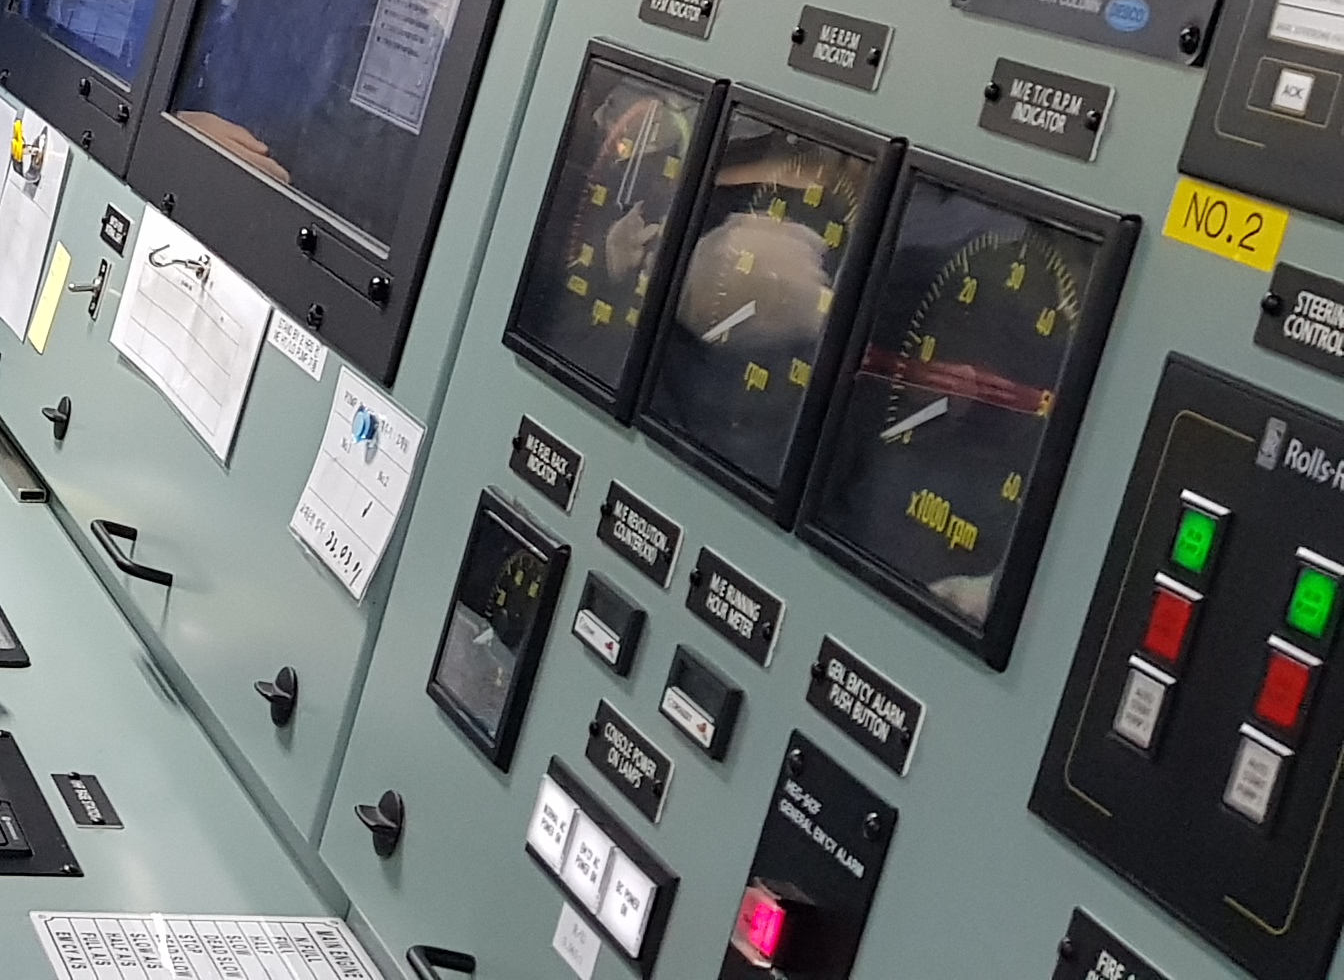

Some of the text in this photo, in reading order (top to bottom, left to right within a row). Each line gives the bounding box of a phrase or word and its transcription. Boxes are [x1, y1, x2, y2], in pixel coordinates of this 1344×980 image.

[666, 0, 702, 23] INDICATOR
[813, 42, 857, 69] INDICATOR
[1010, 77, 1033, 102] M/E
[1033, 84, 1054, 108] T/C
[1012, 101, 1067, 134] INDICATOR
[1184, 191, 1264, 252] NO.2
[958, 275, 978, 305] 20
[1003, 261, 1026, 291] 30
[1035, 306, 1057, 337] 40
[1293, 290, 1344, 329] STEERIN
[919, 334, 937, 363] 10
[526, 452, 558, 487] INDICATOR
[627, 511, 669, 551] REVOLUTION
[906, 488, 980, 552] x1000 rpm
[709, 572, 762, 623] M/E RUNNING
[705, 593, 755, 640] HOUR METER
[829, 682, 853, 716] PUSH
[850, 699, 891, 744] BUTTON
[604, 721, 658, 779] CONSOLE POWER
[607, 747, 644, 789] ON LAMPS
[777, 797, 814, 835] GENERAL
[834, 843, 866, 880] ALARM
[80, 932, 112, 967] FULL A/S
[105, 932, 137, 968] HALF A/S
[130, 933, 164, 970] SLOW A/S
[178, 934, 203, 954] STOP
[203, 934, 244, 979] DEAD SLOW
[225, 935, 253, 956] SLOW
[248, 935, 275, 955] HALF
[272, 936, 295, 954] FULL
[315, 930, 364, 979] MAIN ENGINE
[66, 955, 88, 970] A/S
